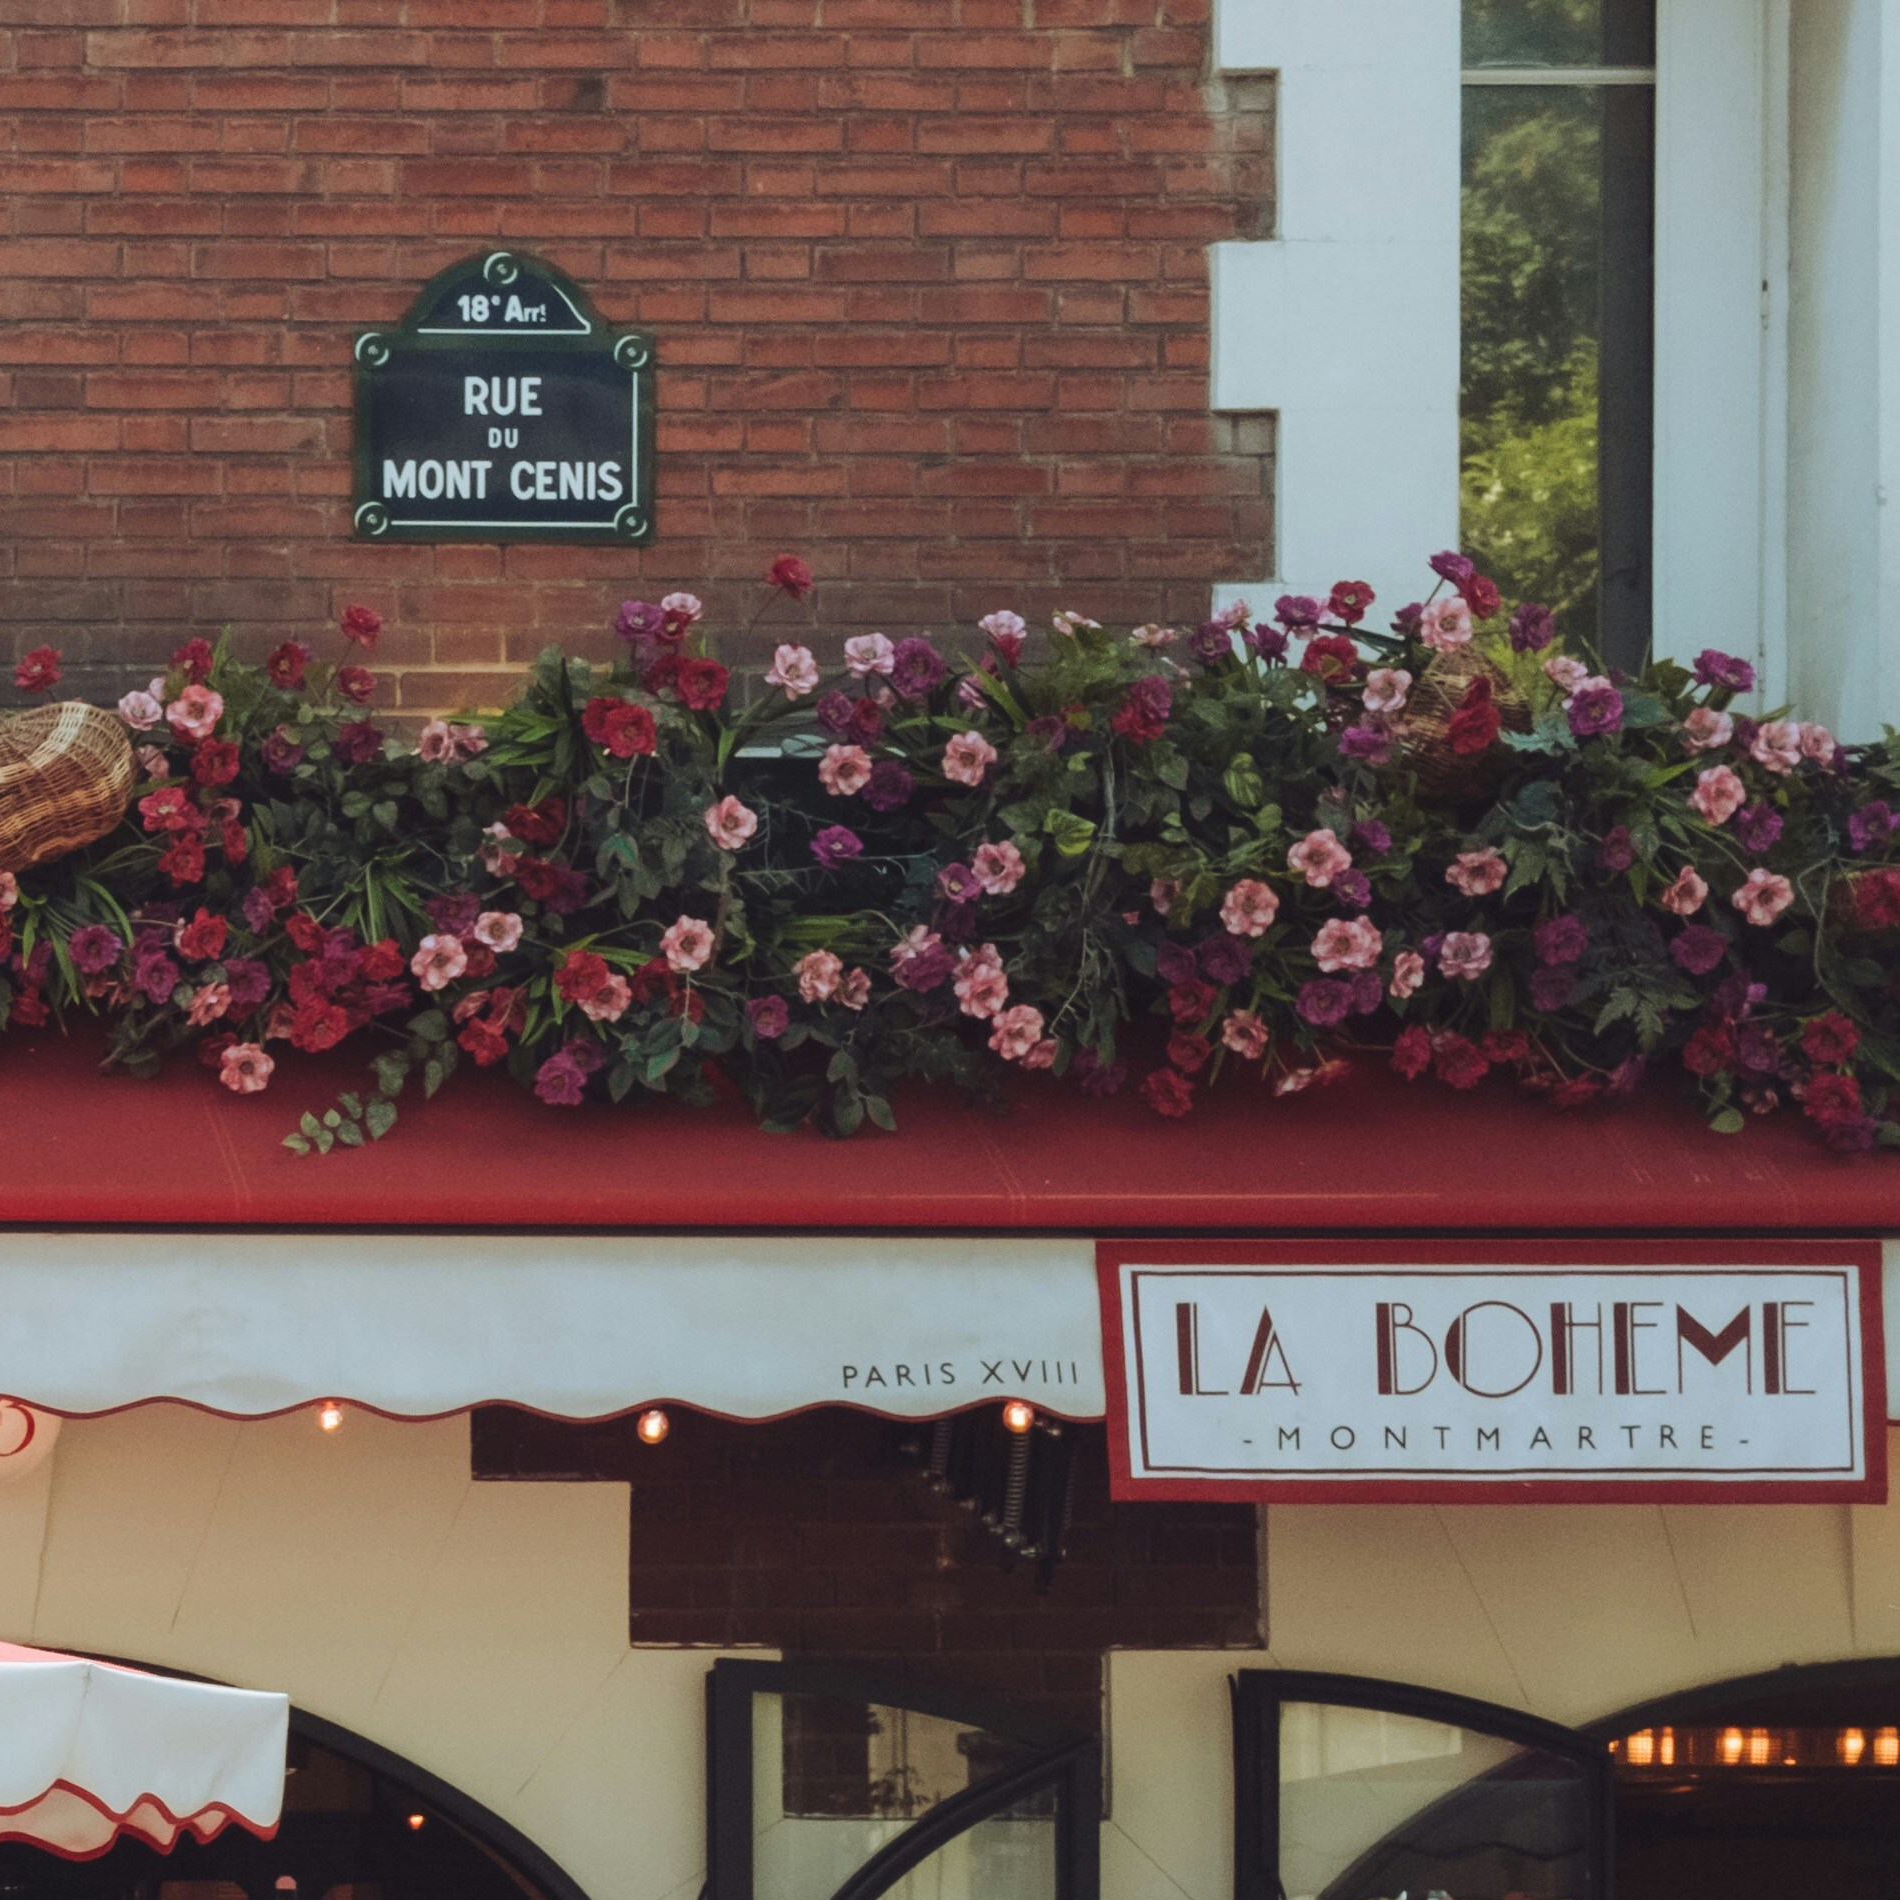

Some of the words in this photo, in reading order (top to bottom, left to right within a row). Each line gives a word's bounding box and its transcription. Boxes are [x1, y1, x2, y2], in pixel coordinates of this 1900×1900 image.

[464, 376, 543, 416] RUE
[487, 427, 519, 449] DU
[382, 459, 493, 500] MONT
[509, 460, 623, 501] CENIS
[1175, 1302, 1300, 1396] LA
[1374, 1300, 1816, 1398] BOHEME
[840, 1363, 958, 1390] PARIS
[981, 1360, 1079, 1385] XVIII
